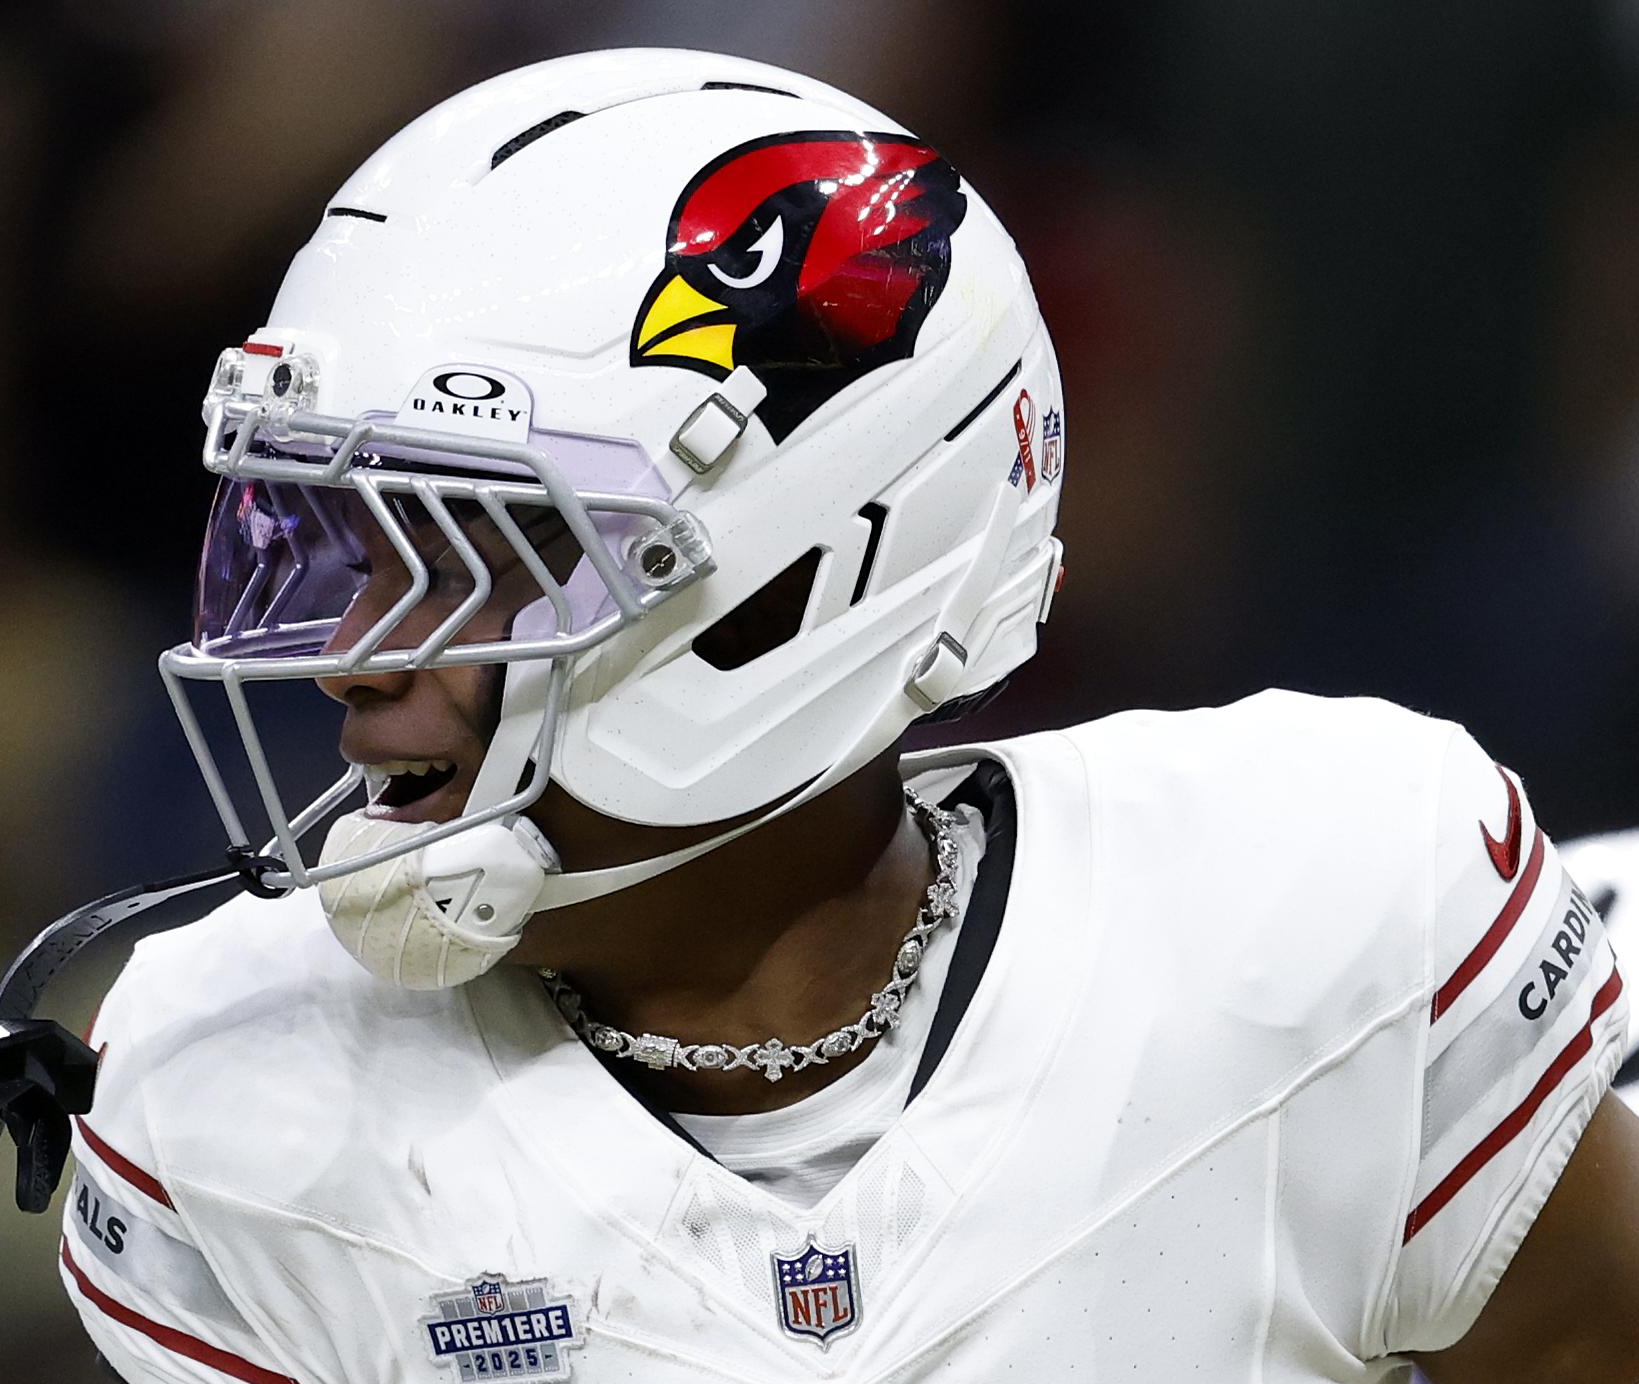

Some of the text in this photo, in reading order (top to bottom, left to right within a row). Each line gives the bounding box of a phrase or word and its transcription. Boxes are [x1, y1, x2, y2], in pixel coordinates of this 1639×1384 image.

[413, 398, 521, 422] OAKLEY
[1042, 439, 1061, 477] NFL
[75, 1178, 128, 1255] ALS
[477, 1295, 503, 1313] NFL
[788, 1283, 850, 1329] NFL
[434, 1309, 567, 1351] PREM1ERE
[475, 1347, 539, 1373] 2025
